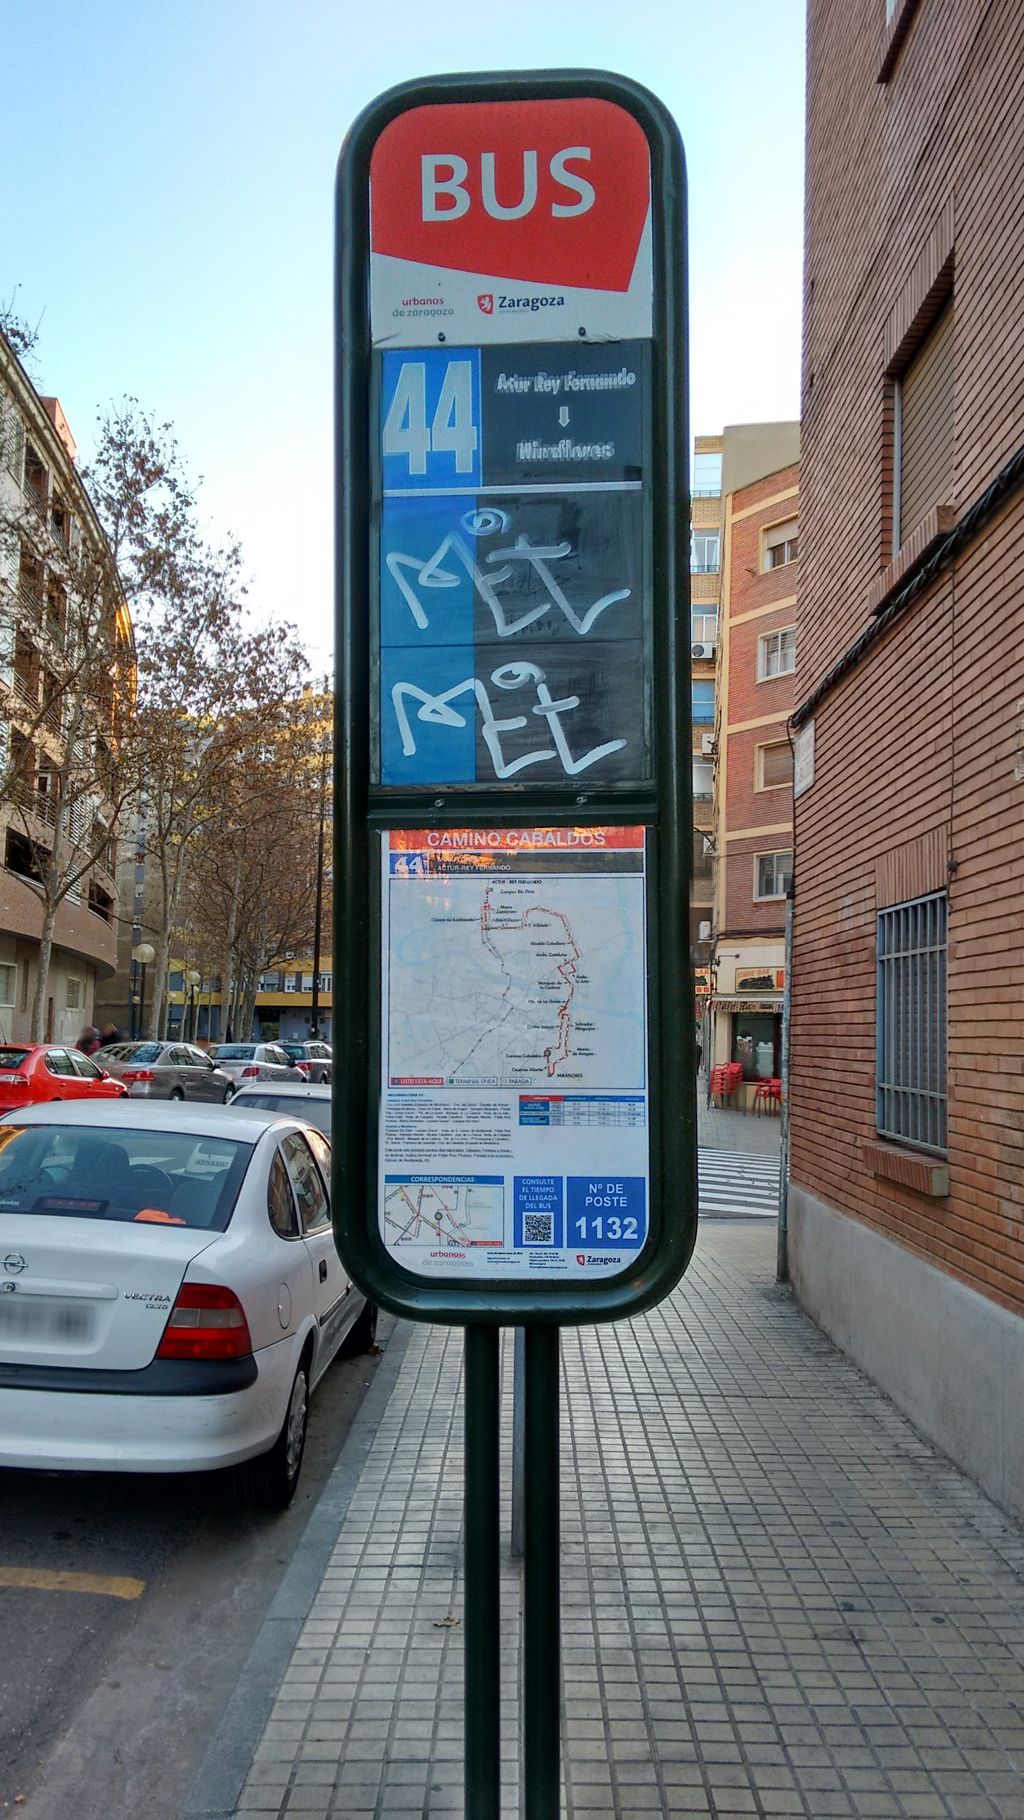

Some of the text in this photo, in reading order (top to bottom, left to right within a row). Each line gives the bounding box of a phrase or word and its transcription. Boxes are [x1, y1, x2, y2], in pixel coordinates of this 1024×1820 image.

[421, 146, 596, 222] BUS
[402, 296, 444, 306] urbanos
[498, 295, 565, 311] Zaragoza
[392, 308, 454, 318] de zaragoza
[534, 374, 561, 395] Rey
[383, 361, 477, 475] 44
[516, 439, 615, 462] Miraflores
[427, 831, 606, 847] CAMINO CABALDOS
[394, 856, 423, 874] 44
[589, 1183, 624, 1194] Nº DE
[585, 1196, 628, 1207] POSTE
[575, 1216, 638, 1240] 1132
[587, 1255, 621, 1266] Zaragoza
[123, 1291, 171, 1302] VECTRA
